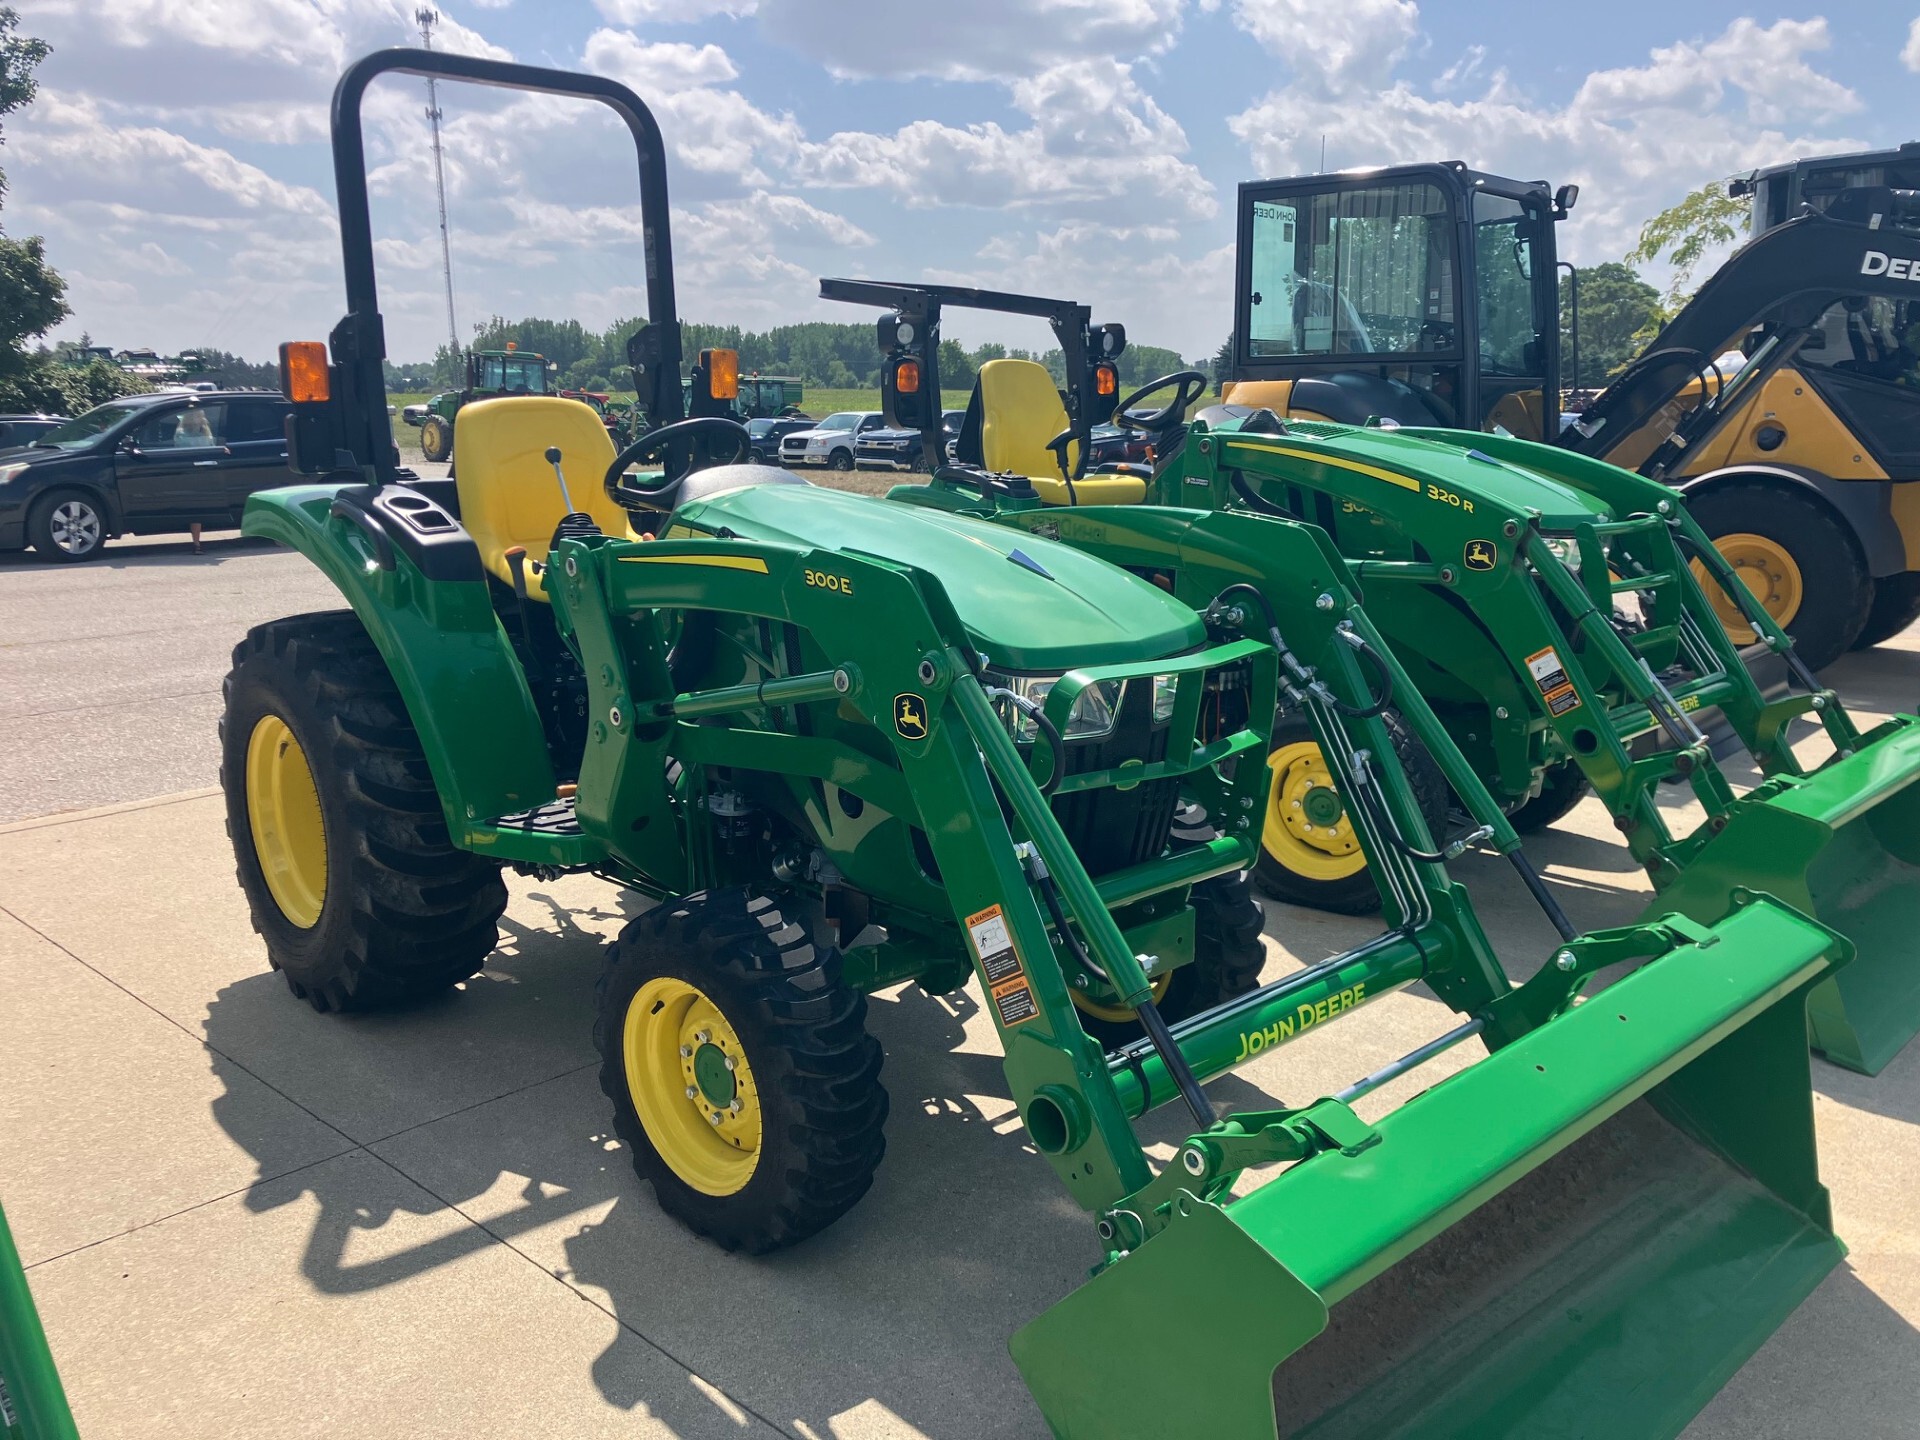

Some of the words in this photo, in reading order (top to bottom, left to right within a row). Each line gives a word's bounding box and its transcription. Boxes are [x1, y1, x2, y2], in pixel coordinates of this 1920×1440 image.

[974, 907, 998, 923] WARNING
[1001, 980, 1025, 993] WARNING
[1235, 1015, 1294, 1063] JOHN
[1297, 983, 1366, 1031] DEERE
